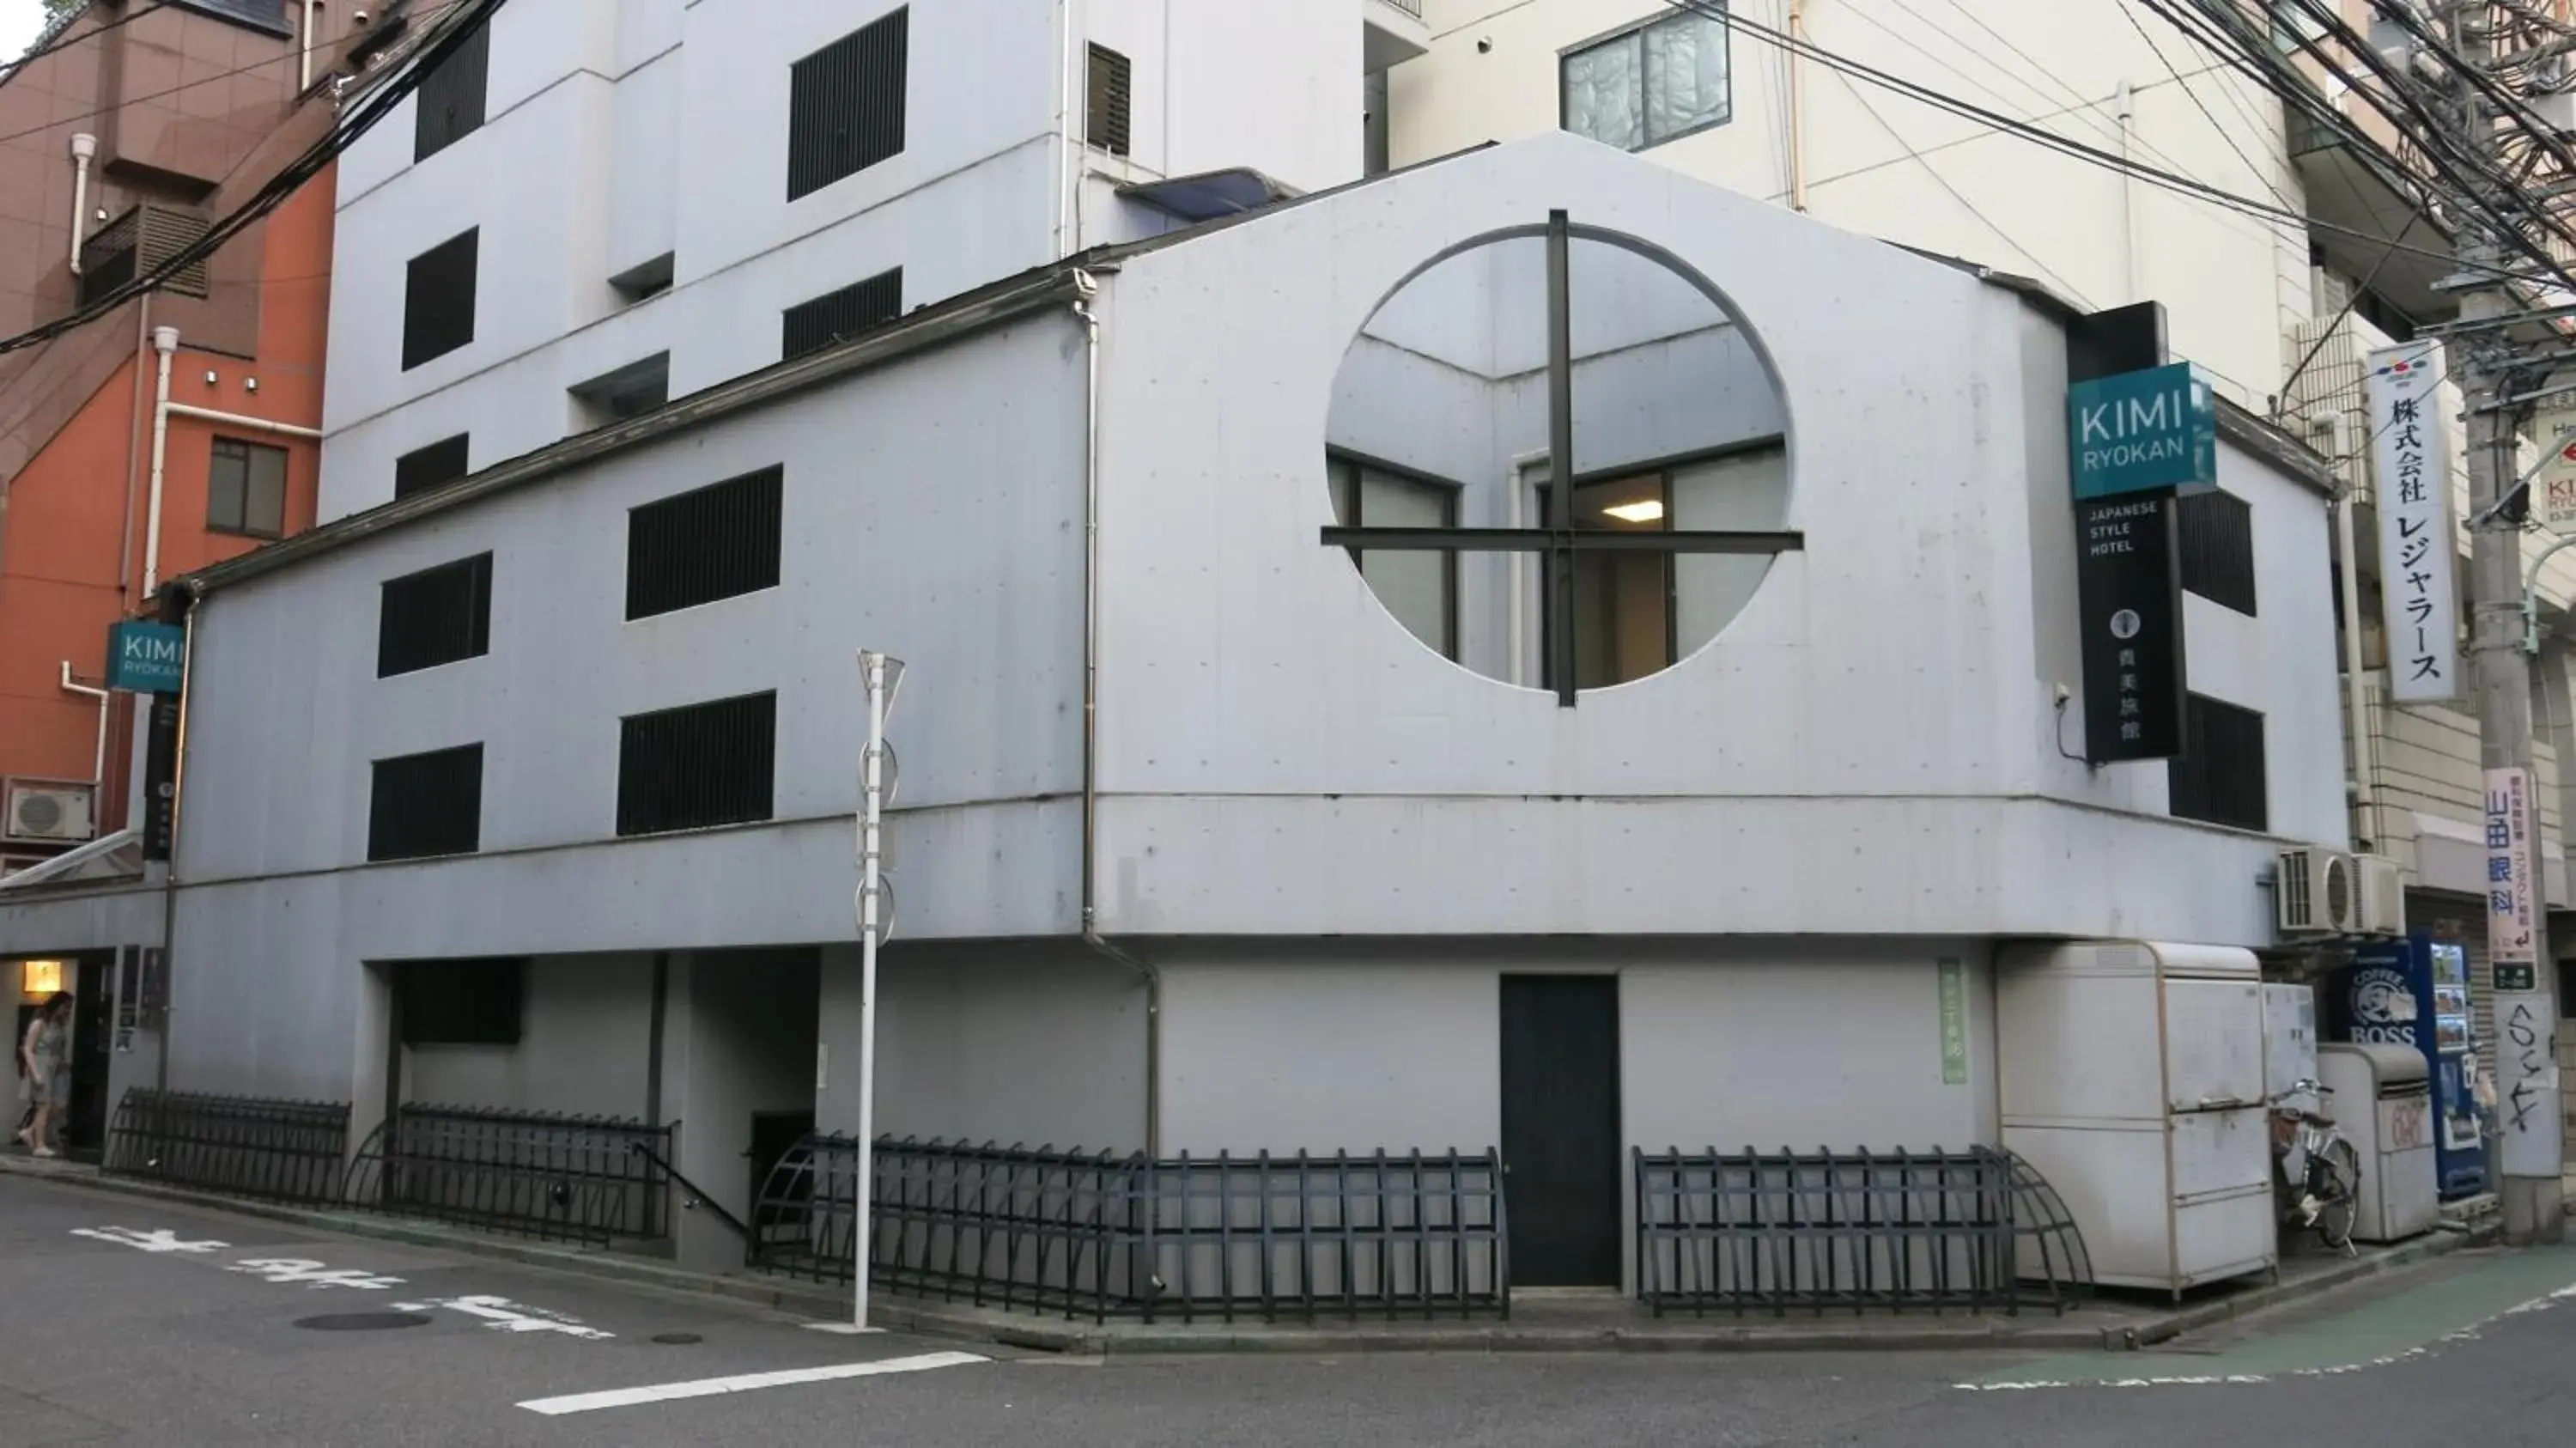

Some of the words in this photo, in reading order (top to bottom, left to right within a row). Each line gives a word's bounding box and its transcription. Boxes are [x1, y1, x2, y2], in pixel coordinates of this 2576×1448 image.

[2081, 389, 2183, 445] KIMI
[2083, 435, 2184, 472] RYOKAN
[2392, 397, 2427, 505] 株式会社
[2089, 500, 2158, 522] JAPANESE
[2090, 522, 2131, 539] STYLE
[2090, 540, 2135, 557] HOTEL
[2397, 517, 2441, 681] レジャラース
[124, 634, 184, 664] KIMI
[2349, 1025, 2417, 1047] BOSS
